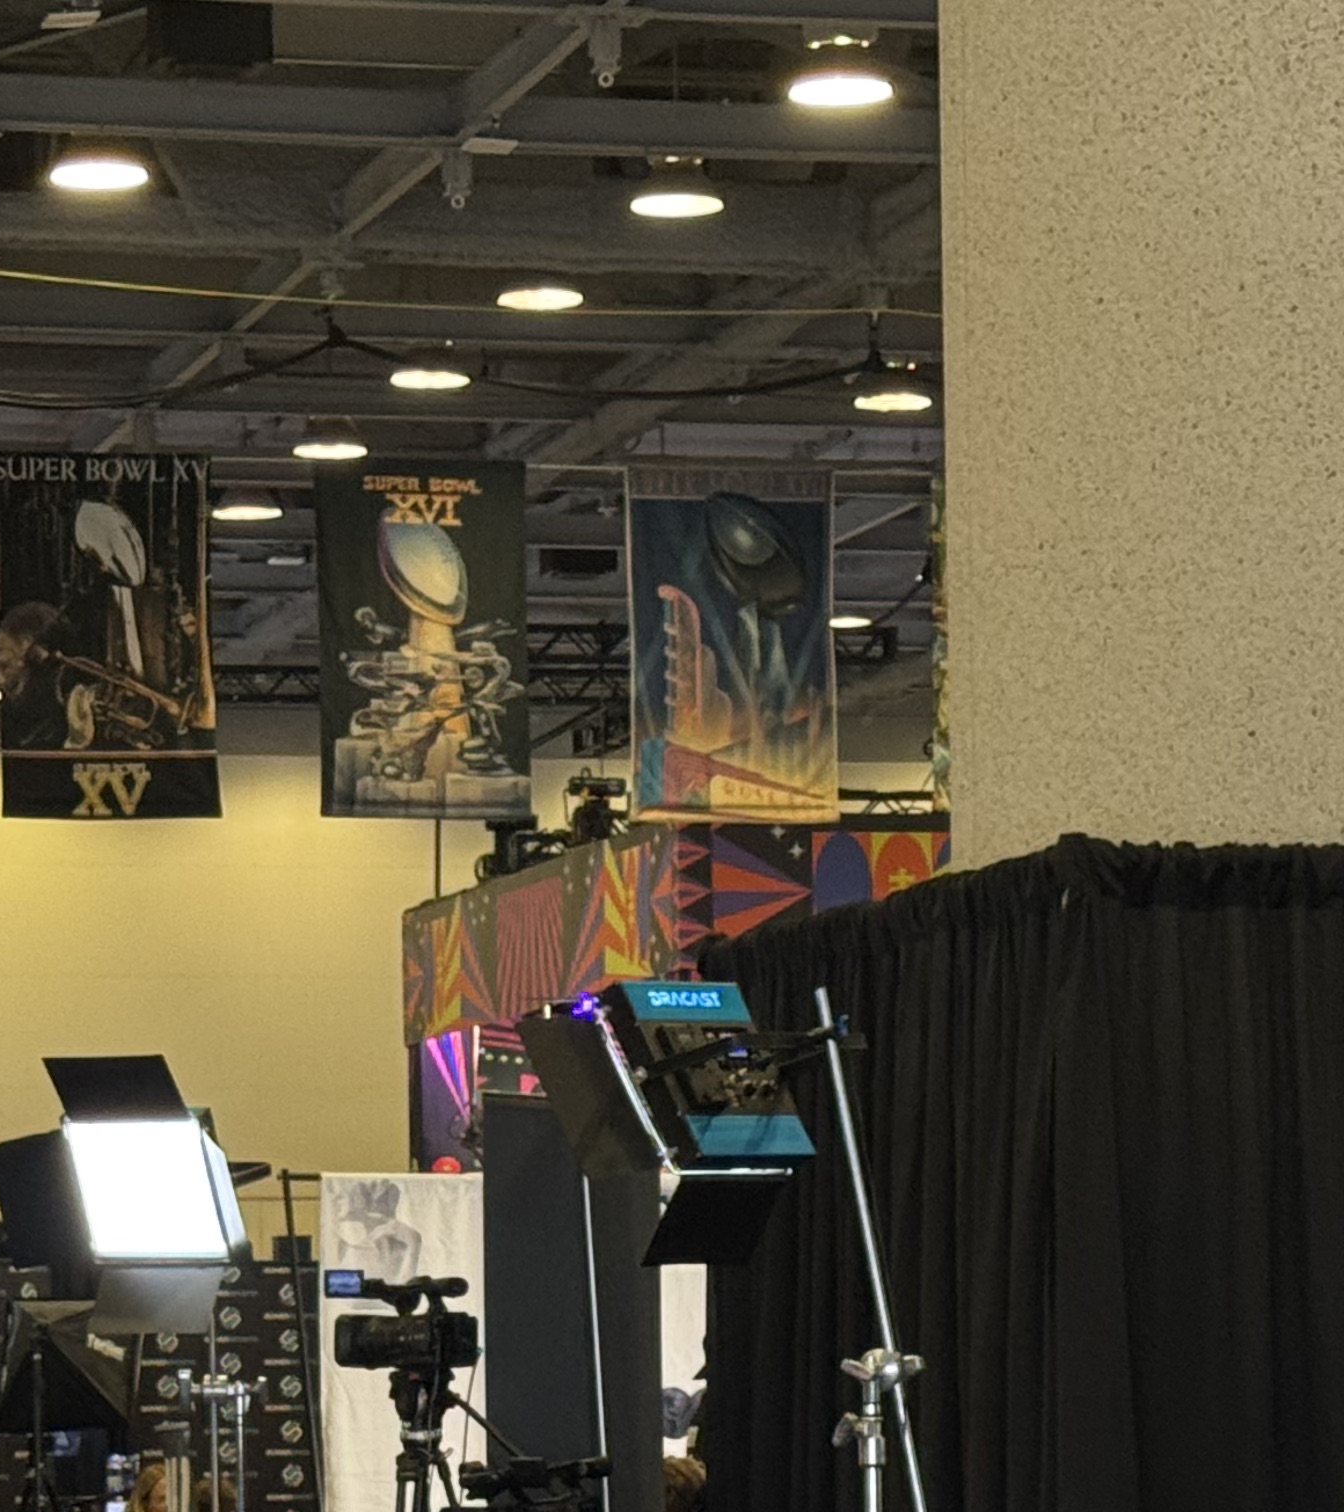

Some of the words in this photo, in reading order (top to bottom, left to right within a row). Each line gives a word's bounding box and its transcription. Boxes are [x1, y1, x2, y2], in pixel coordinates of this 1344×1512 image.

[85, 456, 166, 483] BOWL
[173, 456, 210, 482] XV
[362, 474, 421, 491] SUPER
[428, 477, 483, 495] BOWL
[383, 493, 463, 527] XVI
[72, 762, 152, 816] XV
